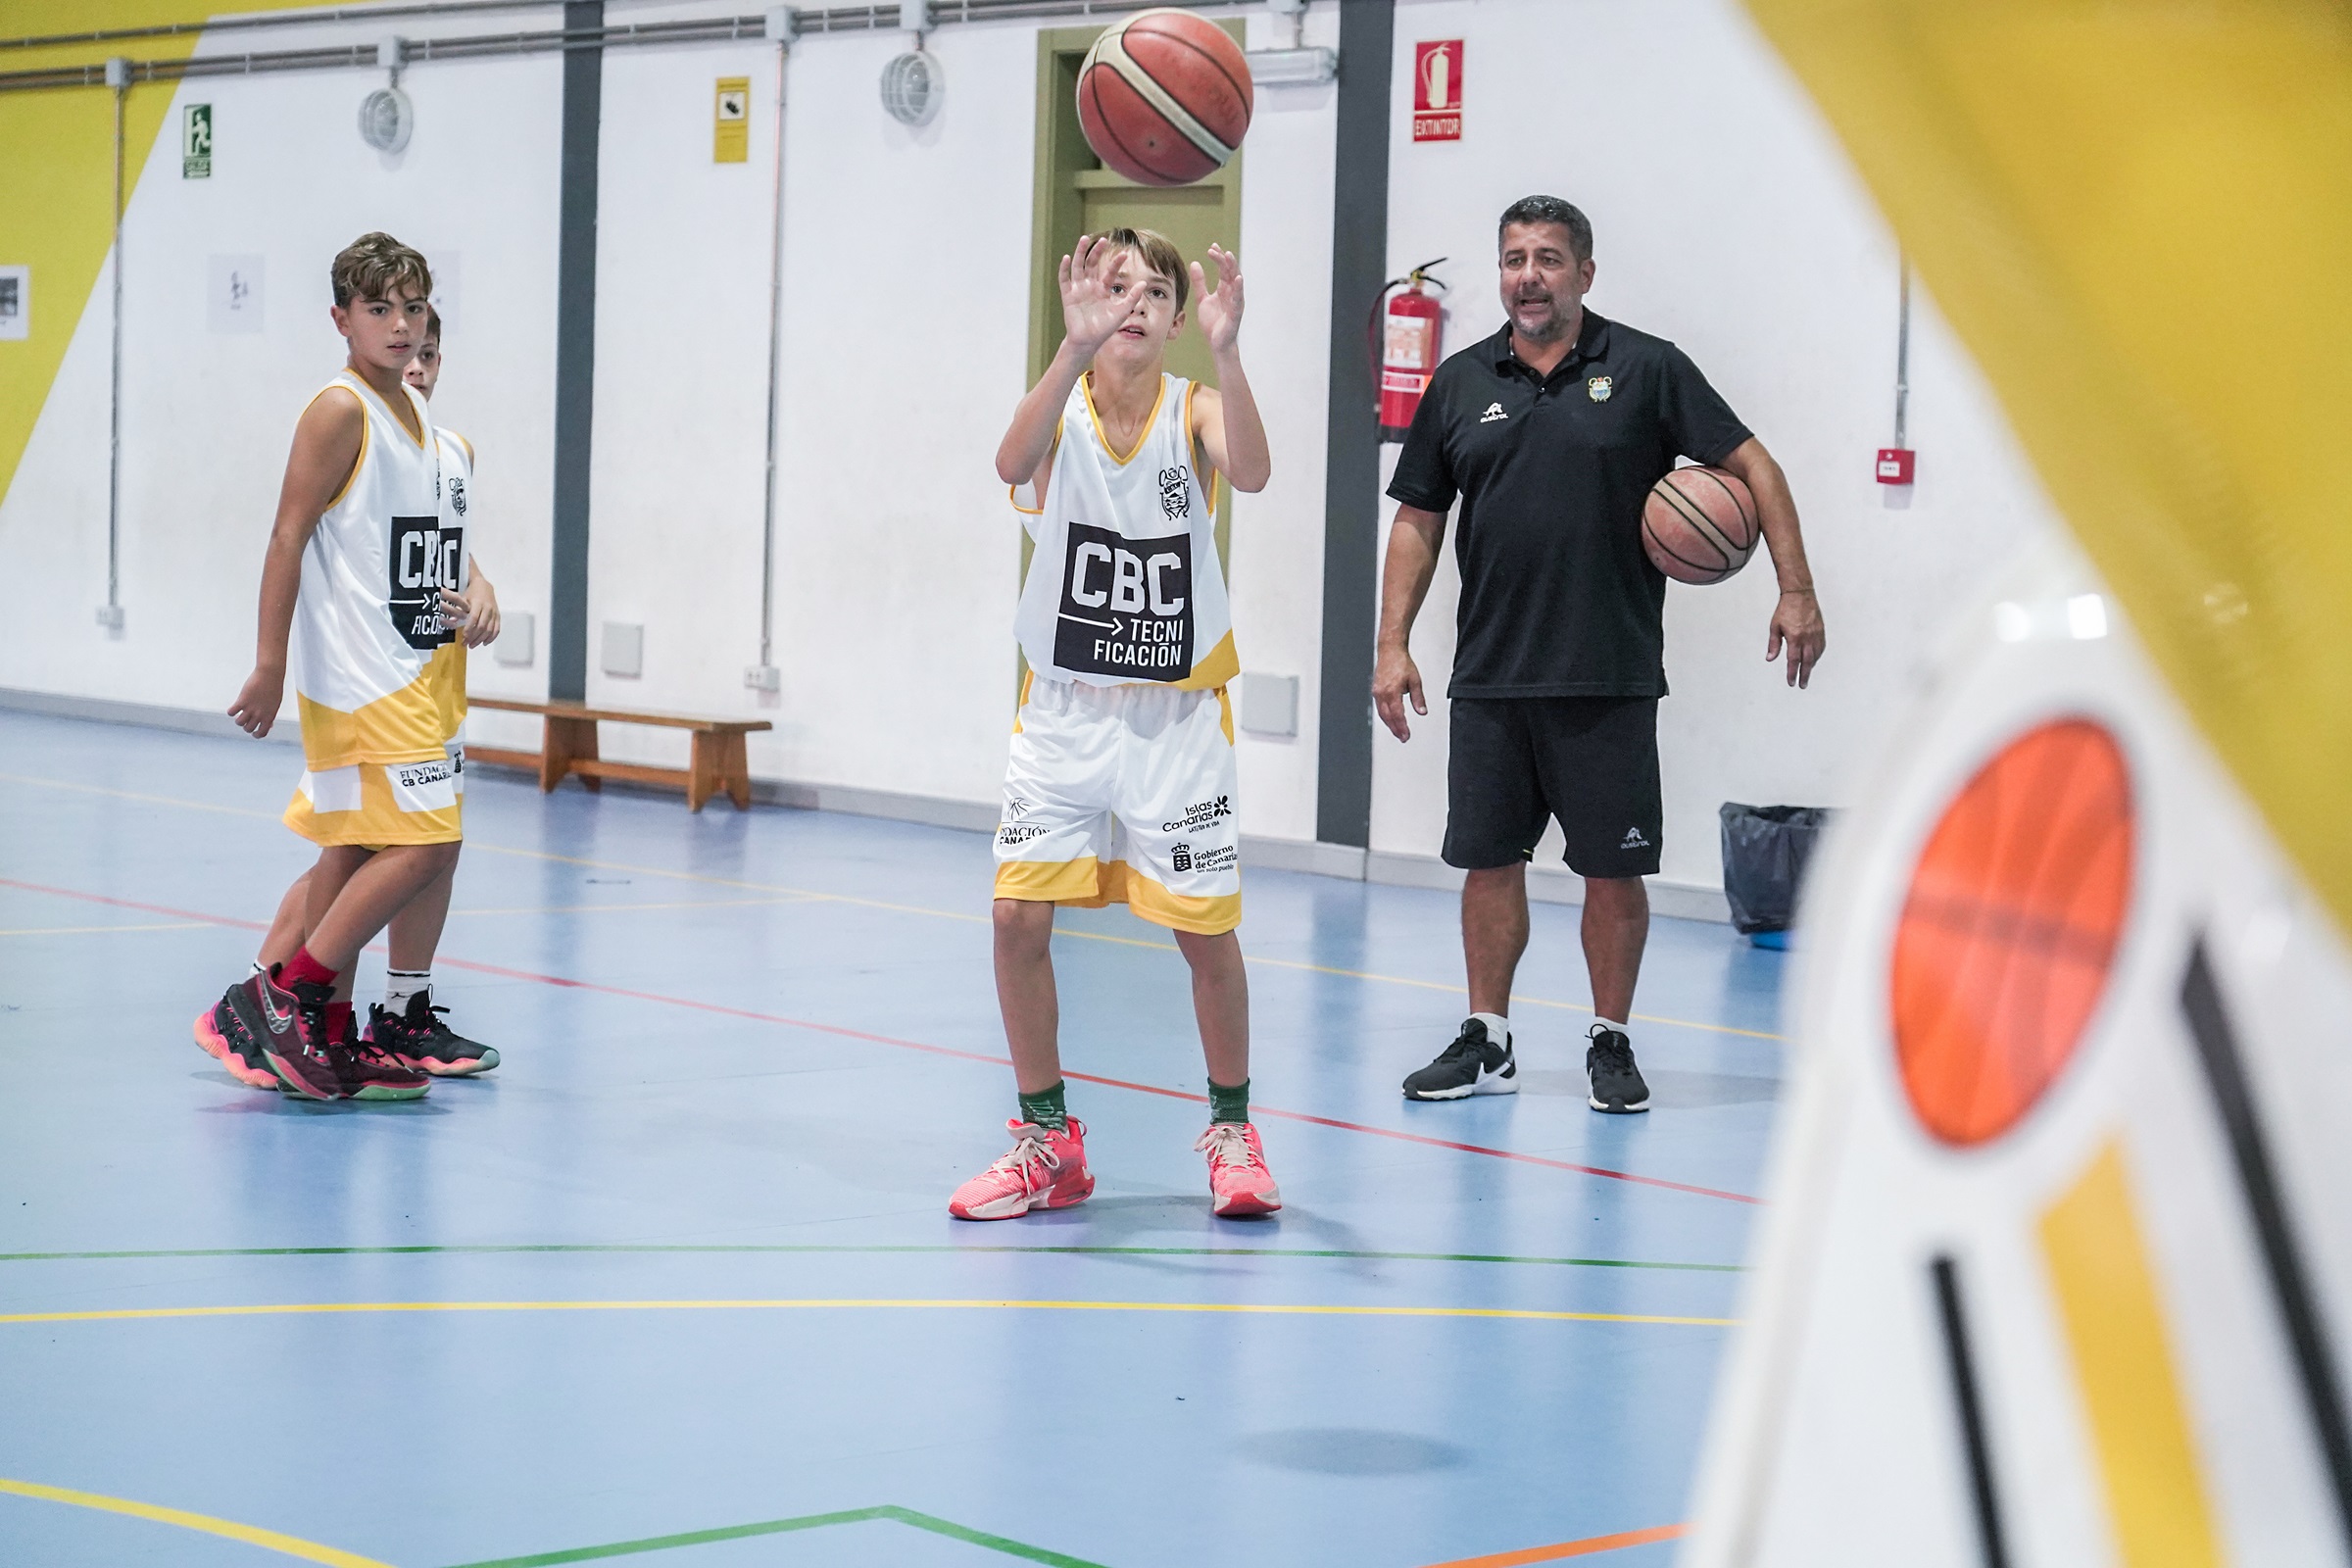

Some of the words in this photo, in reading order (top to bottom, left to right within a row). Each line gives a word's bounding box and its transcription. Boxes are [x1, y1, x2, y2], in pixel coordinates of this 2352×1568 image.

[1415, 119, 1461, 135] EXTINTOR
[1071, 541, 1185, 616] CBC
[1130, 618, 1184, 642] TECNI
[402, 778, 416, 787] CB
[1185, 801, 1212, 816] Islas
[1162, 811, 1213, 832] Canarias
[1194, 845, 1234, 860] Gobierno
